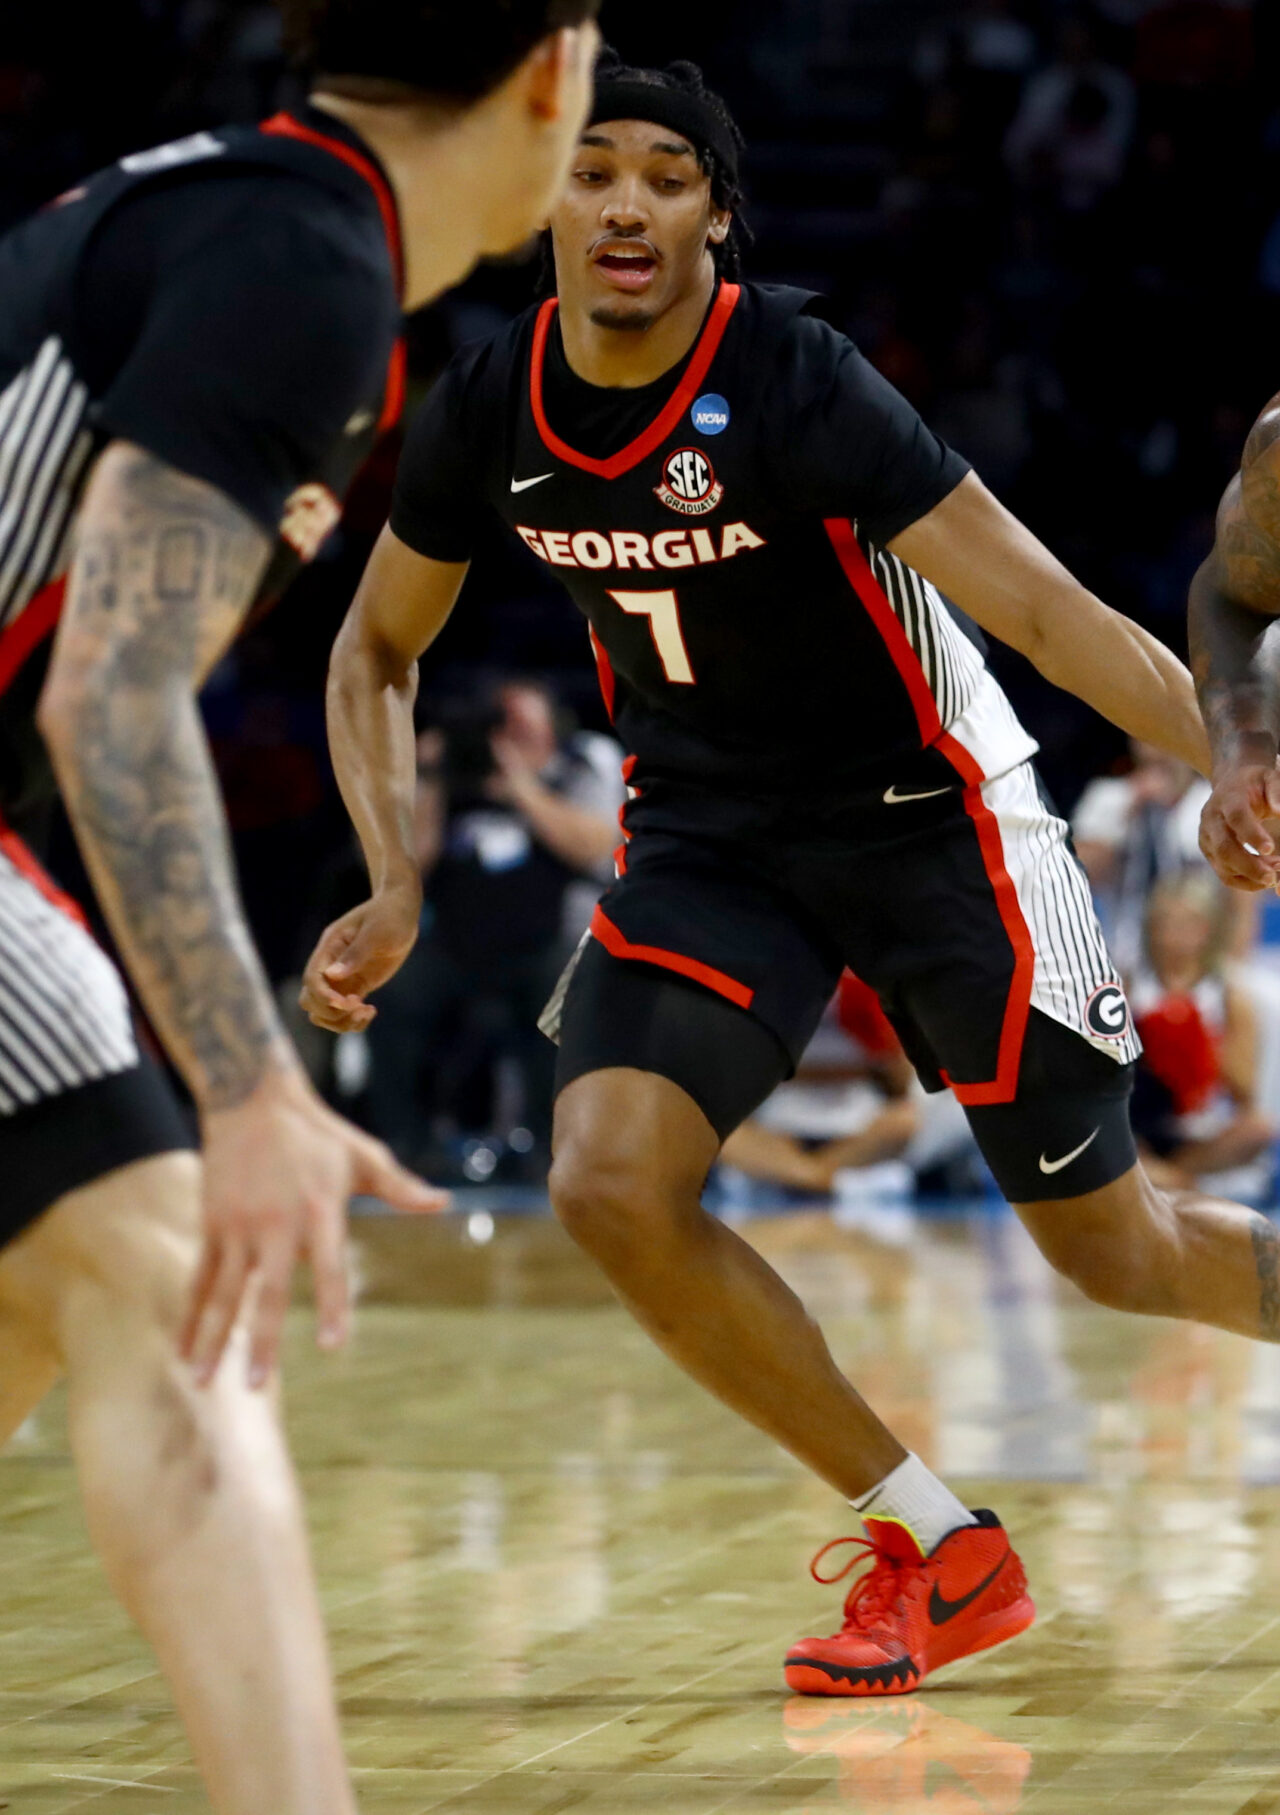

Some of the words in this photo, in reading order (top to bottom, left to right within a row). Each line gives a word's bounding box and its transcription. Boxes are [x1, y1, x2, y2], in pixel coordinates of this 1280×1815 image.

[696, 412, 728, 426] NCAA
[668, 450, 710, 499] SEC
[664, 493, 718, 514] GRADUATE
[516, 521, 767, 570] GEORGIA
[606, 588, 696, 685] 7
[1087, 987, 1127, 1035] G
